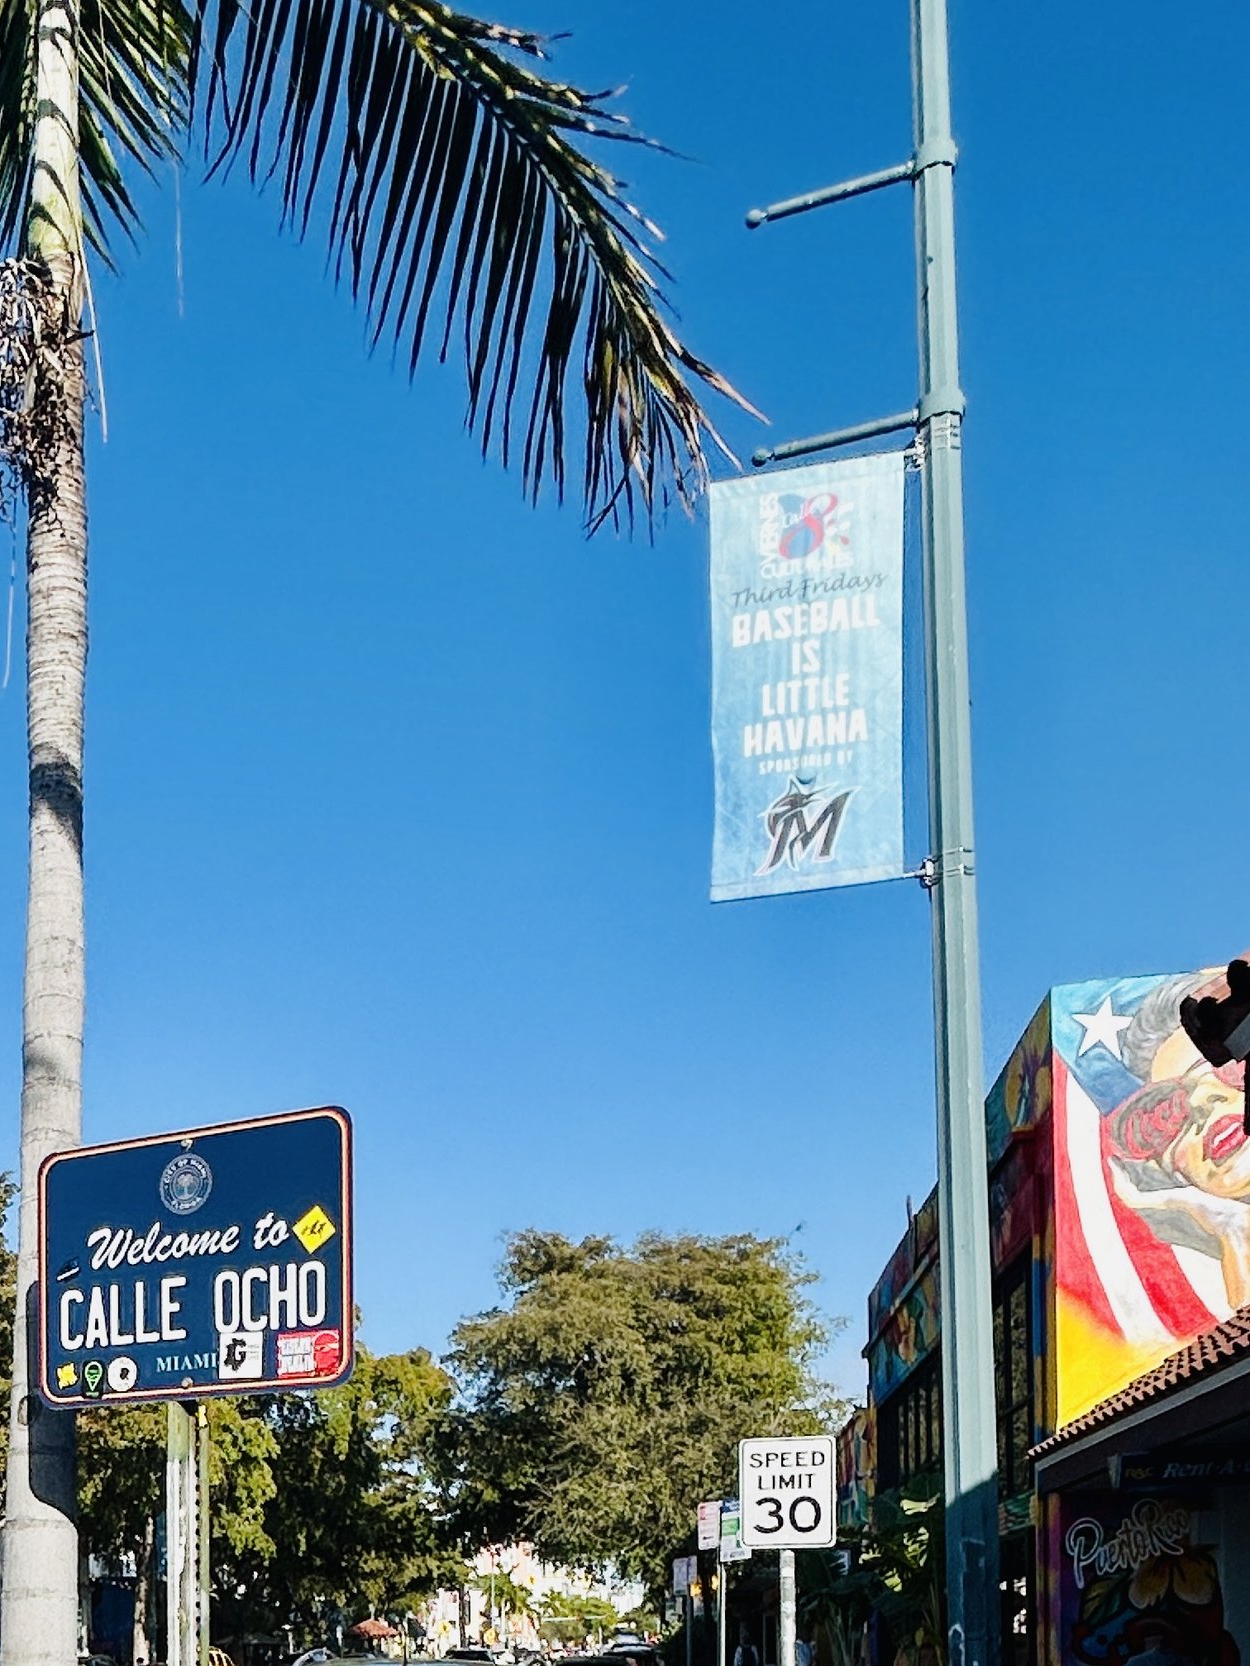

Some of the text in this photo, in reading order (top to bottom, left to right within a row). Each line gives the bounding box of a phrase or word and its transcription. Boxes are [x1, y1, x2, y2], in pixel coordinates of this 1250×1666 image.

[733, 571, 889, 608] Third Fridays
[733, 594, 880, 647] BASEBALL
[792, 639, 820, 675] IS
[762, 672, 850, 717] LITTLE
[744, 708, 868, 758] HAVANA
[759, 749, 854, 776] SPONSORED BY
[87, 1211, 290, 1271] Welcome to
[58, 1260, 326, 1351] CALLE OCHO
[156, 1352, 218, 1373] MIAMI
[749, 1450, 826, 1468] SPEED
[757, 1473, 816, 1490] LIMIT
[753, 1495, 822, 1534] 30
